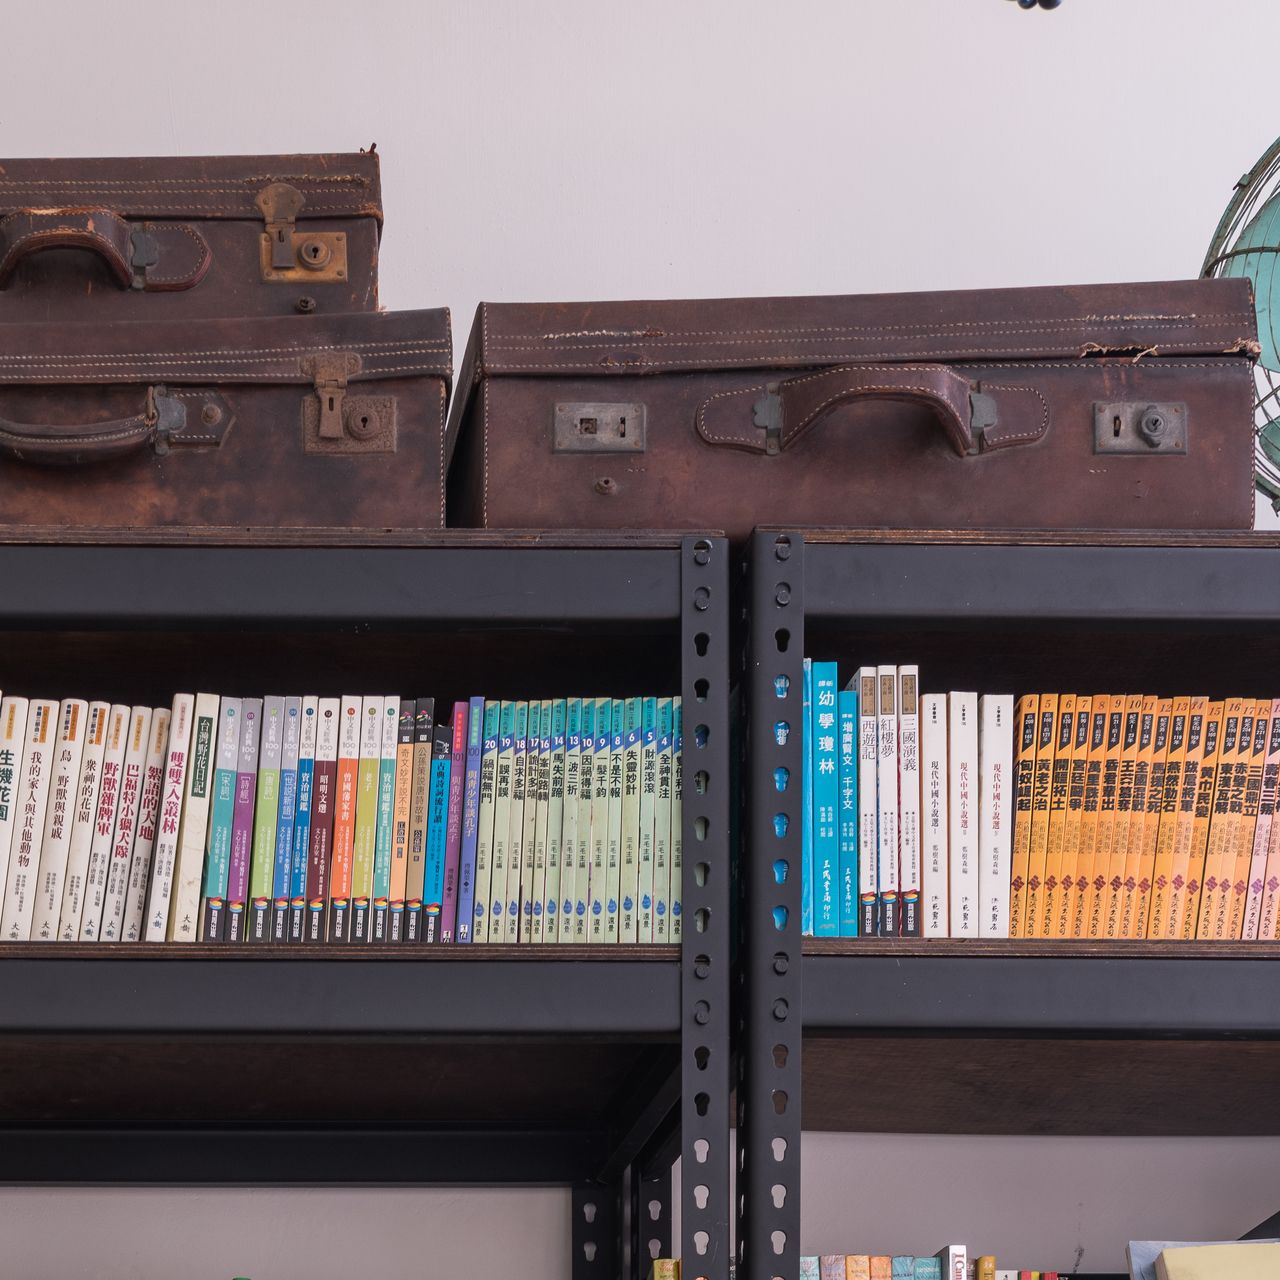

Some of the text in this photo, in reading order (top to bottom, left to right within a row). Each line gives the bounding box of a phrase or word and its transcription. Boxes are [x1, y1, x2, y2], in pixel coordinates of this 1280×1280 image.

[818, 690, 835, 775] 幼學瓊林
[861, 720, 876, 761] 西遊記
[880, 718, 894, 758] 紅樓夢
[902, 718, 917, 771] 三國演義
[193, 719, 211, 796] 台灣野花日記
[497, 757, 511, 798] 一誤再誤
[551, 753, 564, 799] 馬失前蹄
[567, 754, 579, 796] 一波三折
[579, 755, 593, 800] 因禍得福
[610, 753, 622, 799] 不是不報
[625, 750, 639, 796] 失靈妙計
[658, 753, 672, 799] 全神貫注
[97, 762, 120, 836] 野獸雜牌軍
[138, 765, 162, 842] 絮語的大地
[480, 758, 495, 804] 禍福無門
[18, 751, 43, 868] 我的家人與其他動物
[114, 763, 140, 858] 巴福特小獵犬隊
